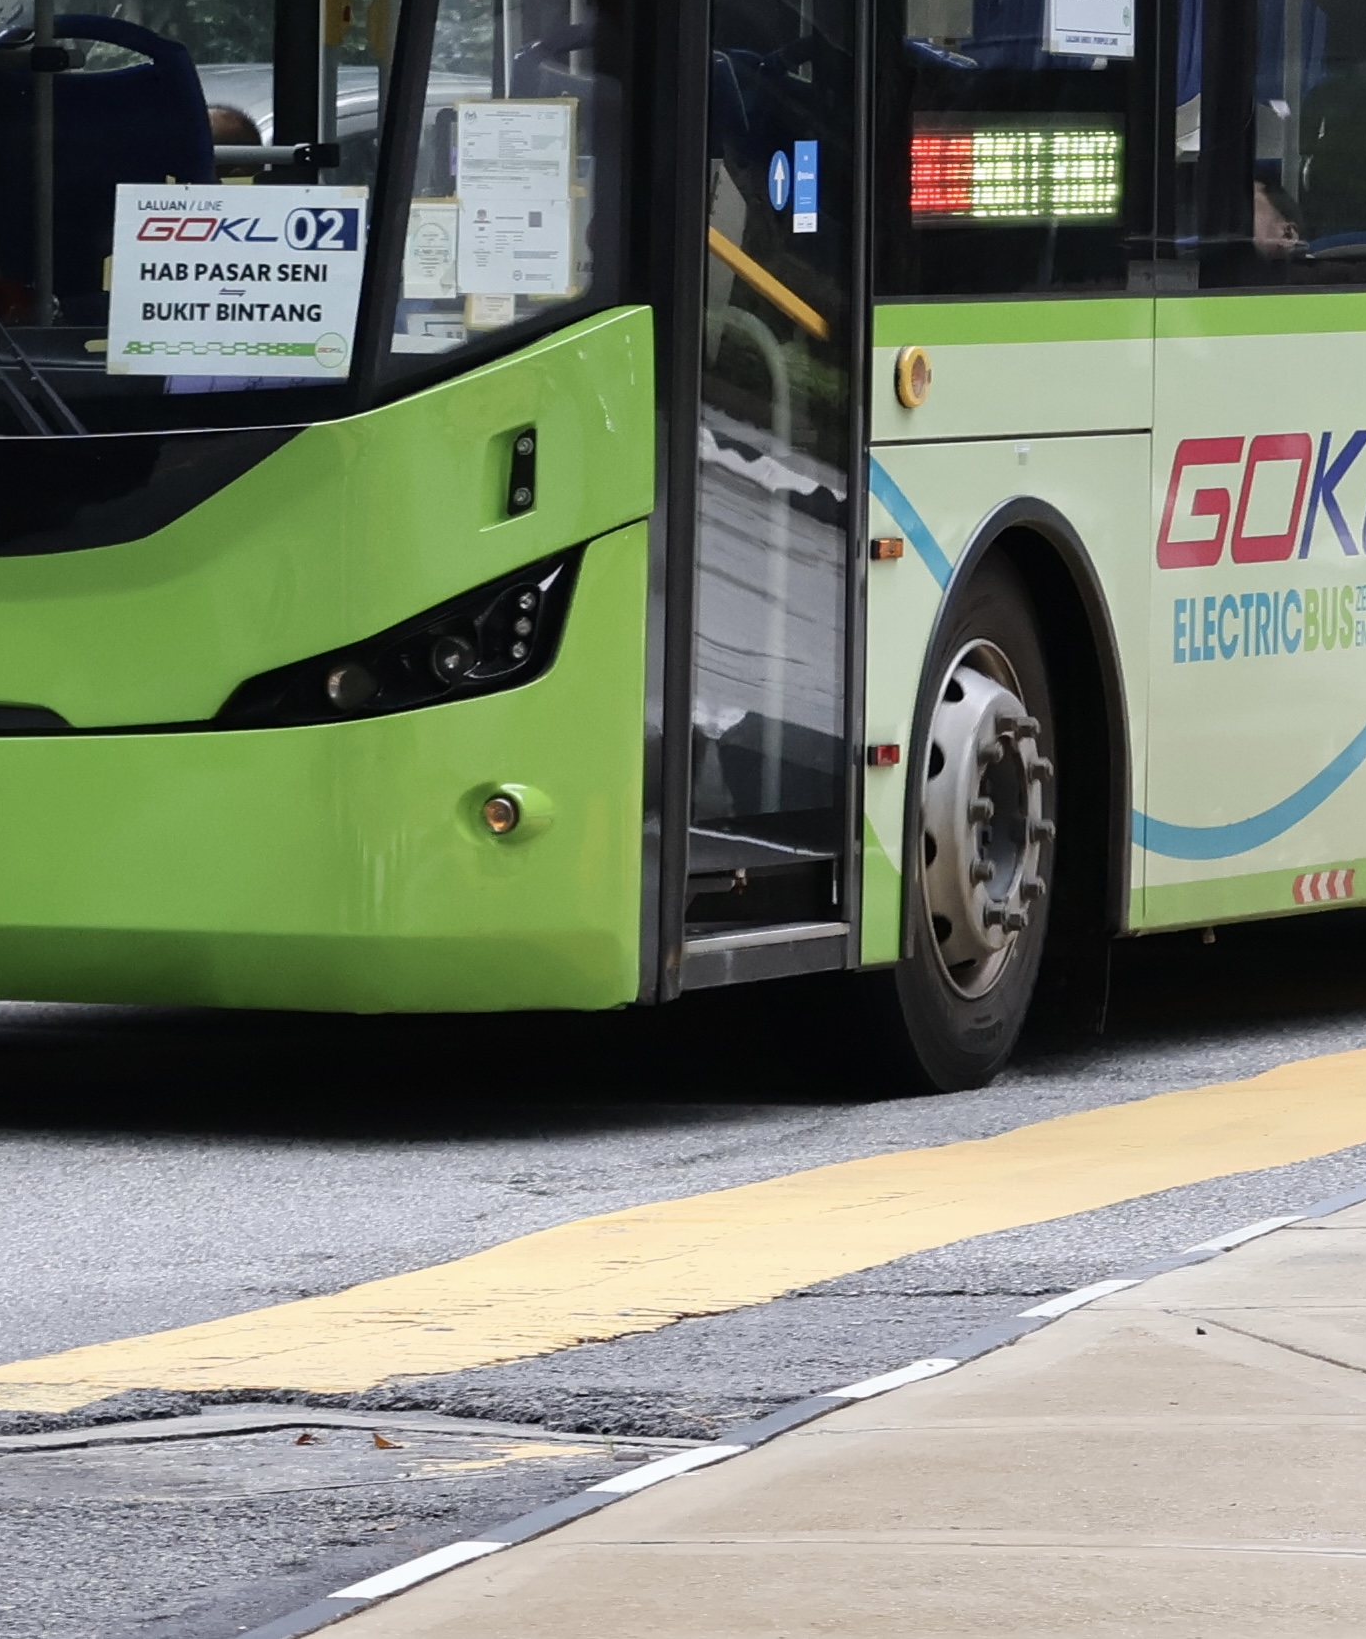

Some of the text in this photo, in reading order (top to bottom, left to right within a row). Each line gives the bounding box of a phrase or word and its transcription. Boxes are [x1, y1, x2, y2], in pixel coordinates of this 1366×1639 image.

[138, 200, 186, 212] LALUAN
[197, 200, 224, 212] LINE
[136, 209, 344, 250] GOKL 02
[140, 263, 328, 283] HAB PASAR SENI
[142, 302, 323, 323] BUKIT BINTANG
